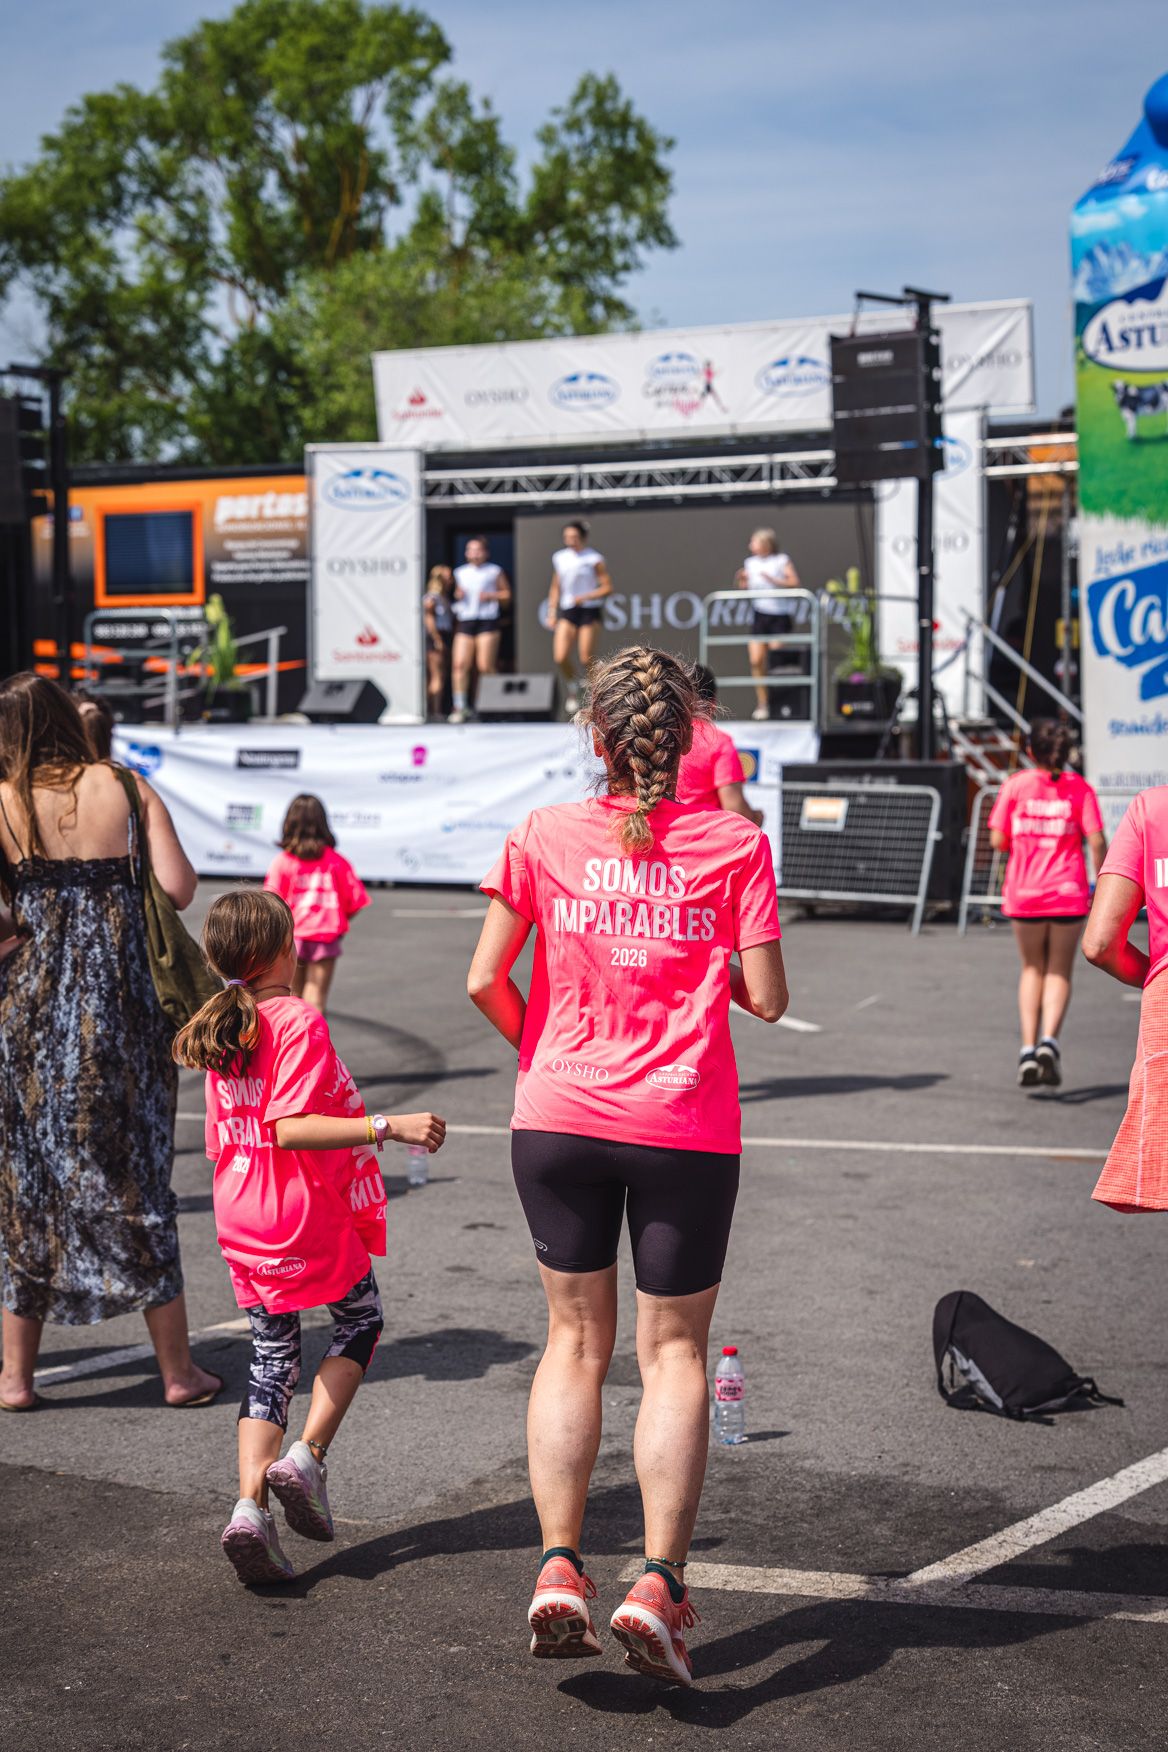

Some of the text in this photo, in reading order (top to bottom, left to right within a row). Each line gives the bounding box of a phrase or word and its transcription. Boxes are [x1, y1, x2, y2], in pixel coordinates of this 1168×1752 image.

[538, 590, 704, 632] SHO
[1099, 578, 1168, 657] Ca
[583, 857, 687, 899] SOMOS
[553, 898, 717, 942] IMPARABLES
[611, 947, 647, 967] 2026
[552, 1058, 609, 1082] OYSHO
[261, 1263, 303, 1276] ASTURIANA
